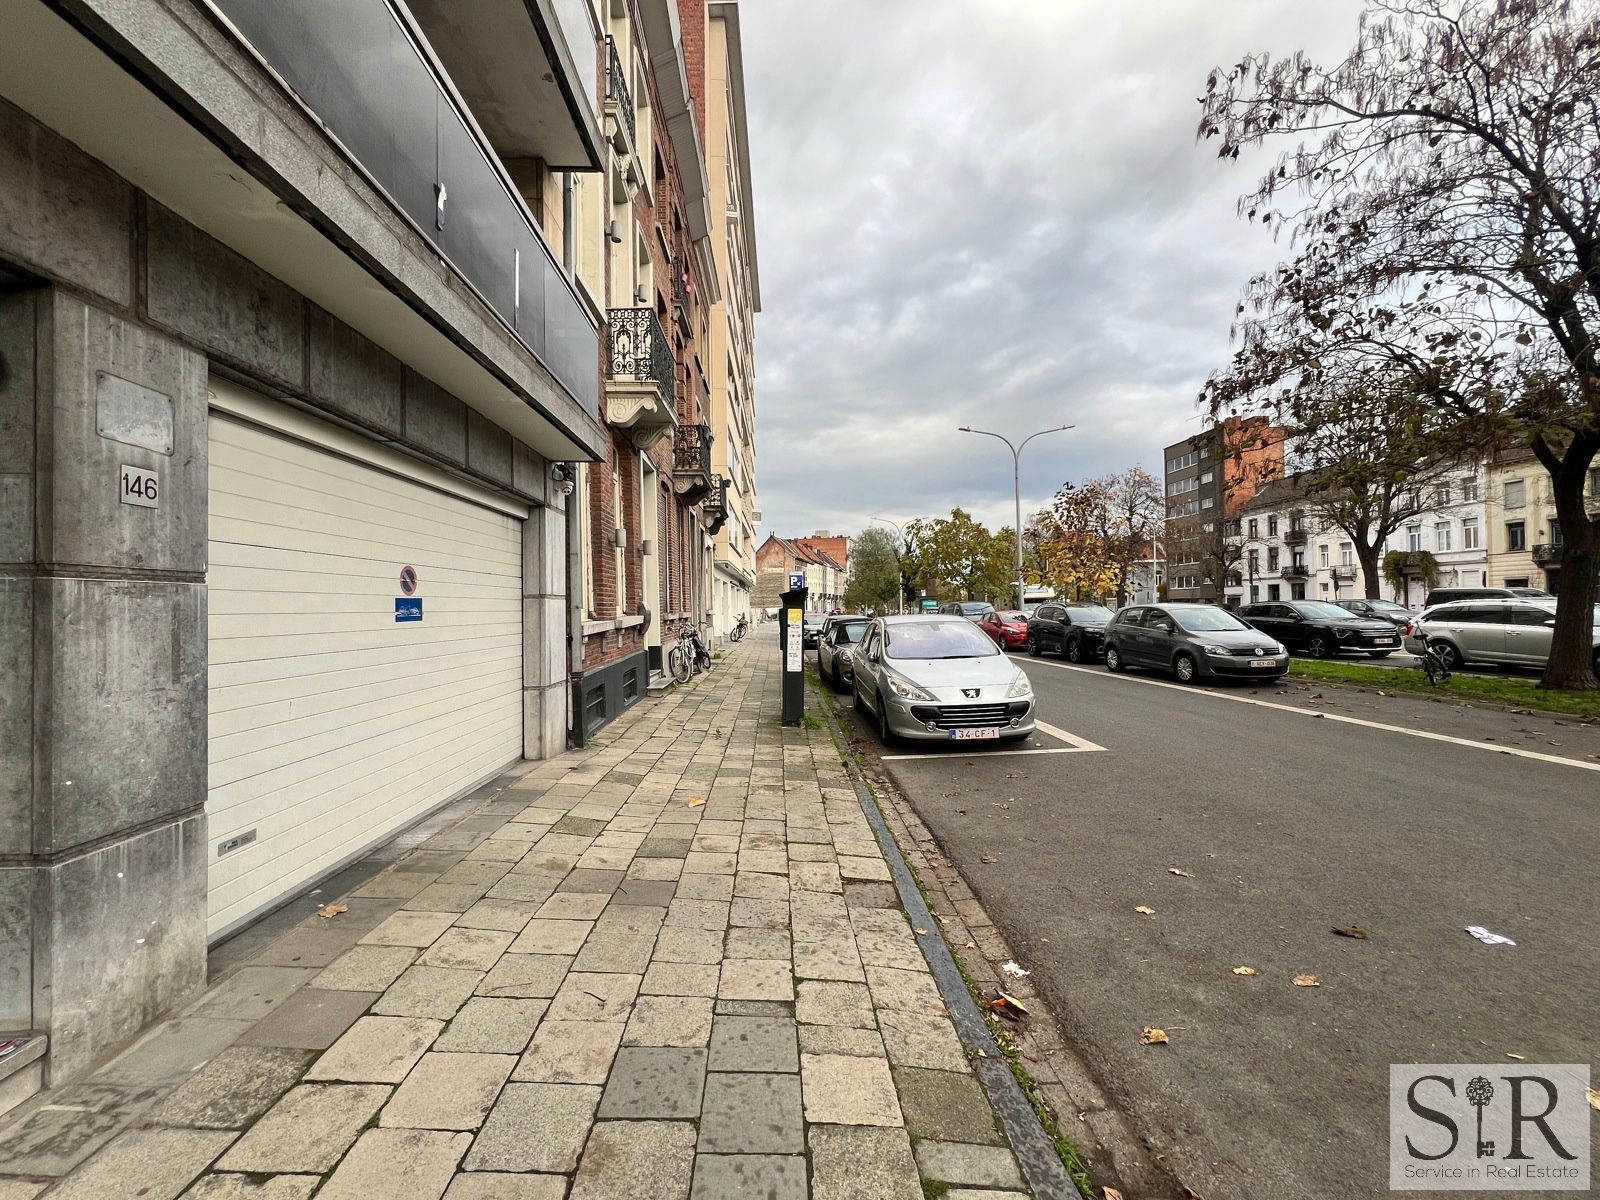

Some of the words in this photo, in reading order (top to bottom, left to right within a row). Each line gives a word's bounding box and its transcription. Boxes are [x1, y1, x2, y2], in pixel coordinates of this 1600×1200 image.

[123, 473, 157, 499] 146
[790, 576, 798, 586] P
[958, 729, 995, 738] 34-CF-1
